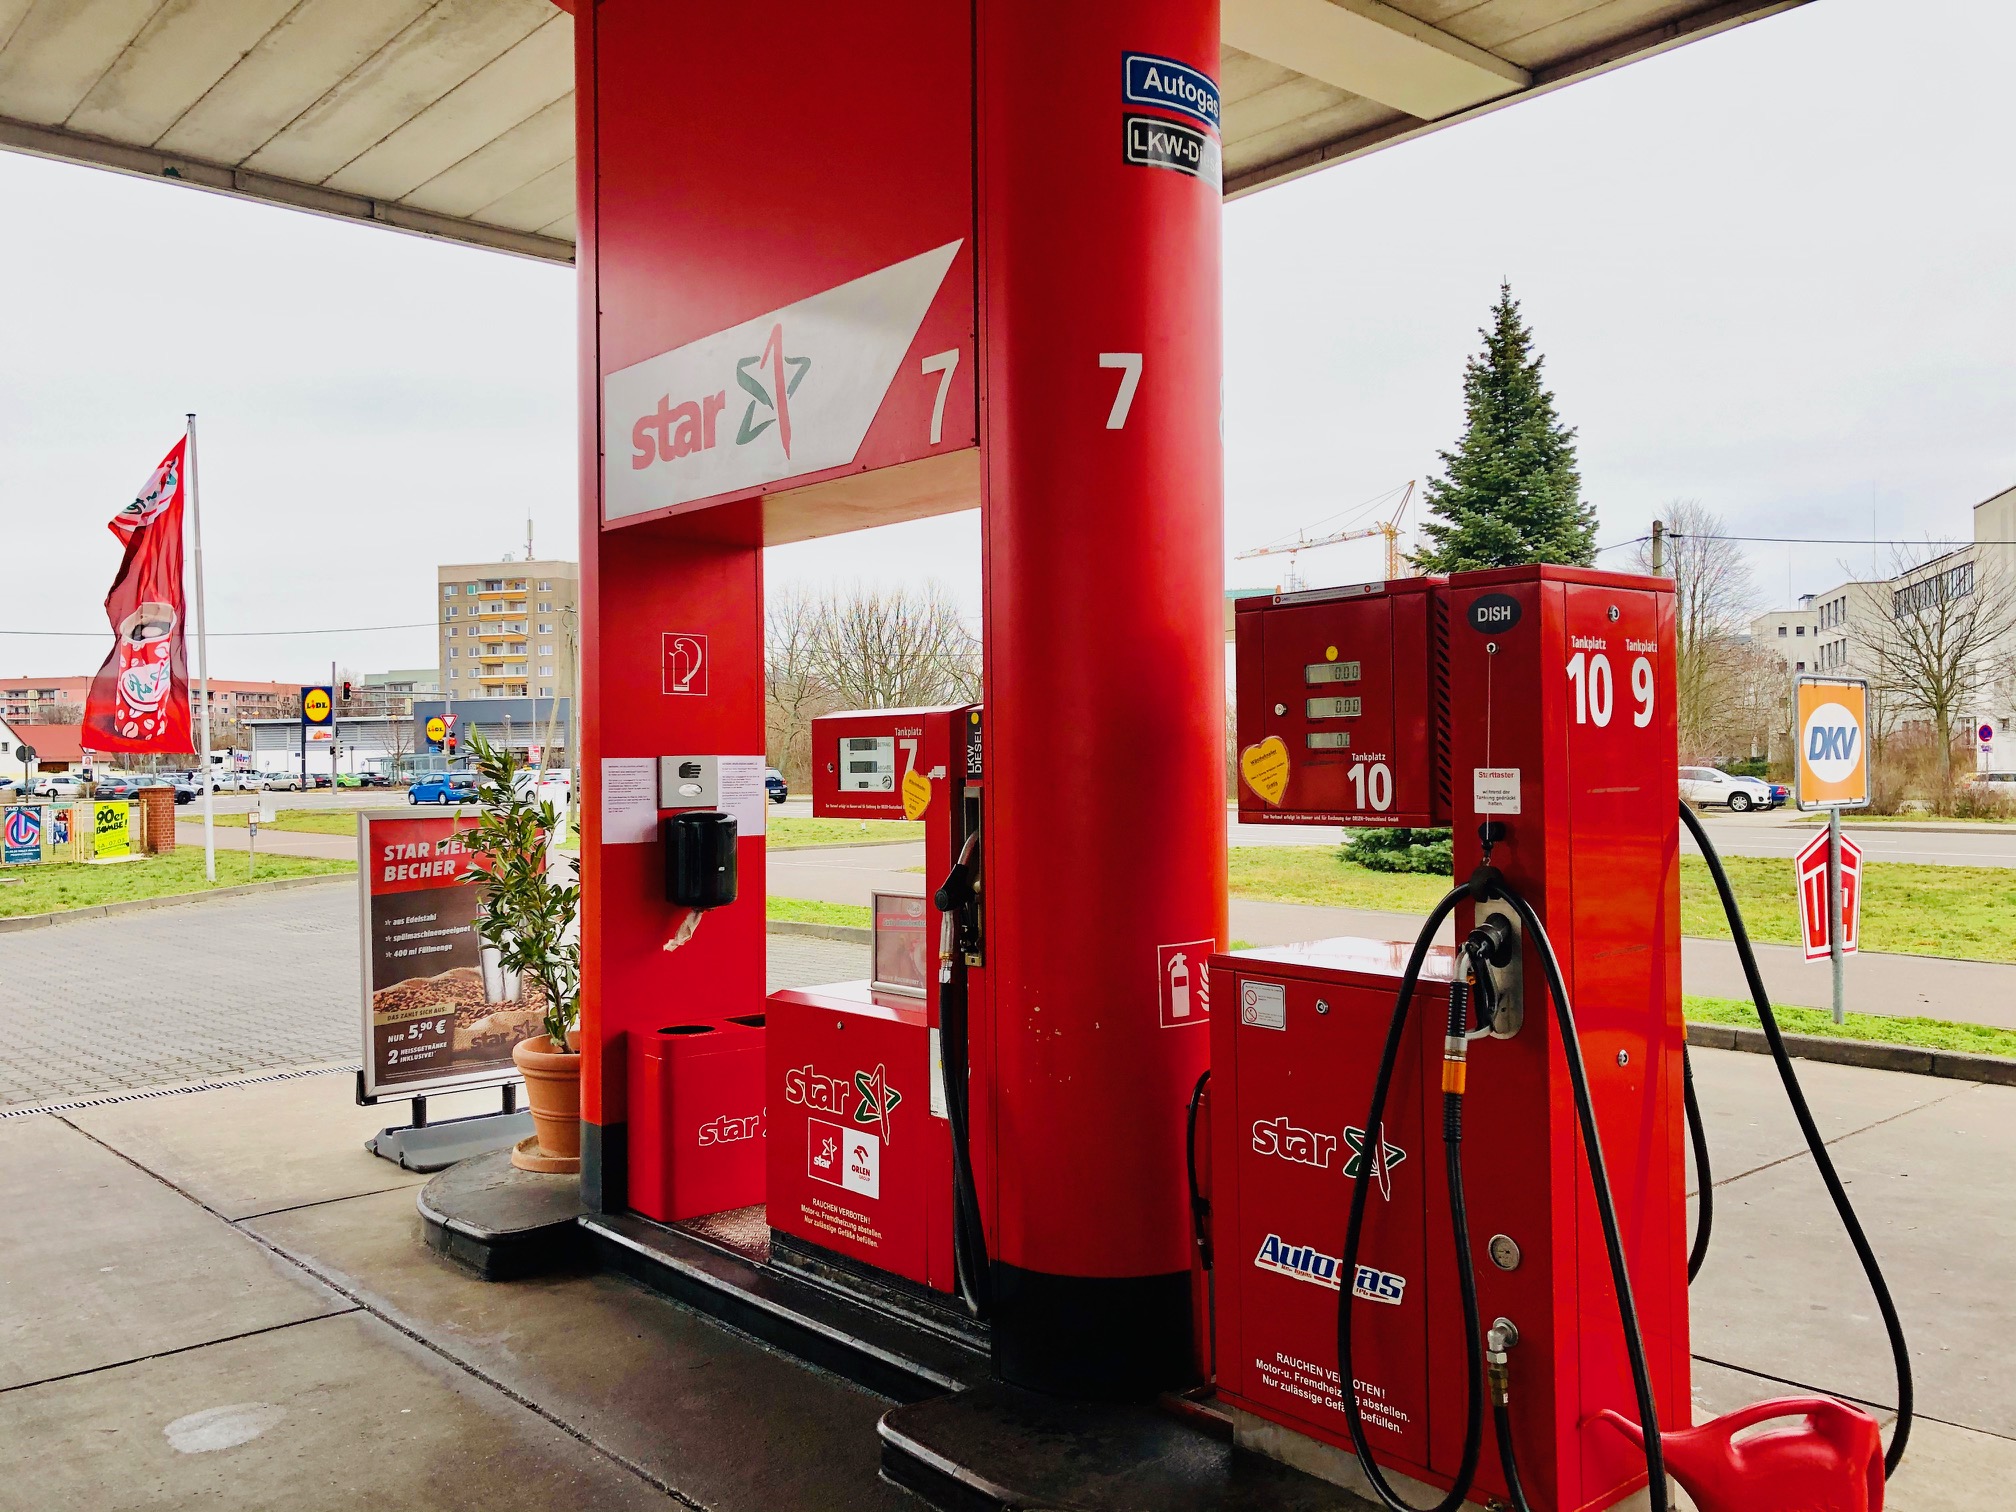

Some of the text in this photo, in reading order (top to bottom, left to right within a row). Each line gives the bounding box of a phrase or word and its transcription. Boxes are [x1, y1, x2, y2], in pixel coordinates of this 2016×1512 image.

[1143, 67, 1219, 118] Autogas
[921, 348, 960, 445] 7
[1099, 352, 1143, 430] 7
[632, 389, 726, 471] star
[1477, 606, 1511, 622] DISH
[1571, 635, 1607, 652] Tankplatz
[1625, 638, 1658, 655] Tankplatz
[1335, 665, 1359, 680] 0.00
[1566, 653, 1614, 728] 10
[1631, 656, 1655, 728] 9
[895, 726, 922, 738] Tankplatz
[1809, 726, 1857, 760] DKV
[900, 739, 917, 774] 7
[967, 745, 975, 773] LKW
[974, 727, 982, 773] DIESEL
[1352, 752, 1386, 765] Tankplatz
[1347, 763, 1393, 812] 10
[384, 842, 430, 861] STAR
[384, 860, 456, 882] BECHER
[392, 913, 437, 926] aus Edelstahl
[393, 925, 471, 942] spülmaschinengeeignet
[393, 944, 453, 958] 400 ml Füllmenge
[387, 1033, 405, 1043] NUR
[435, 1019, 447, 1034] €
[470, 1030, 510, 1050] star
[388, 1041, 448, 1065] 2 HEISSGETRÄNKE
[785, 1064, 850, 1116] star
[698, 1115, 760, 1146] star
[1252, 1116, 1337, 1168] star
[813, 1155, 832, 1169] star
[851, 1164, 871, 1177] ORLEN
[804, 1215, 814, 1225] Nur
[813, 1221, 837, 1234] zulässige
[812, 1197, 871, 1225] RAUCHEN VERBOTEN!
[821, 1211, 857, 1231] Fremdheizung
[1259, 1236, 1404, 1299] Autoas
[1276, 1352, 1386, 1399] RAUCHEN VEOTEN!
[1256, 1358, 1411, 1423] Motor-u. Fremdheizg abstellen.
[1262, 1374, 1279, 1388] Nur
[1280, 1380, 1323, 1405] zulässige
[1360, 1409, 1403, 1434] befüllen.
